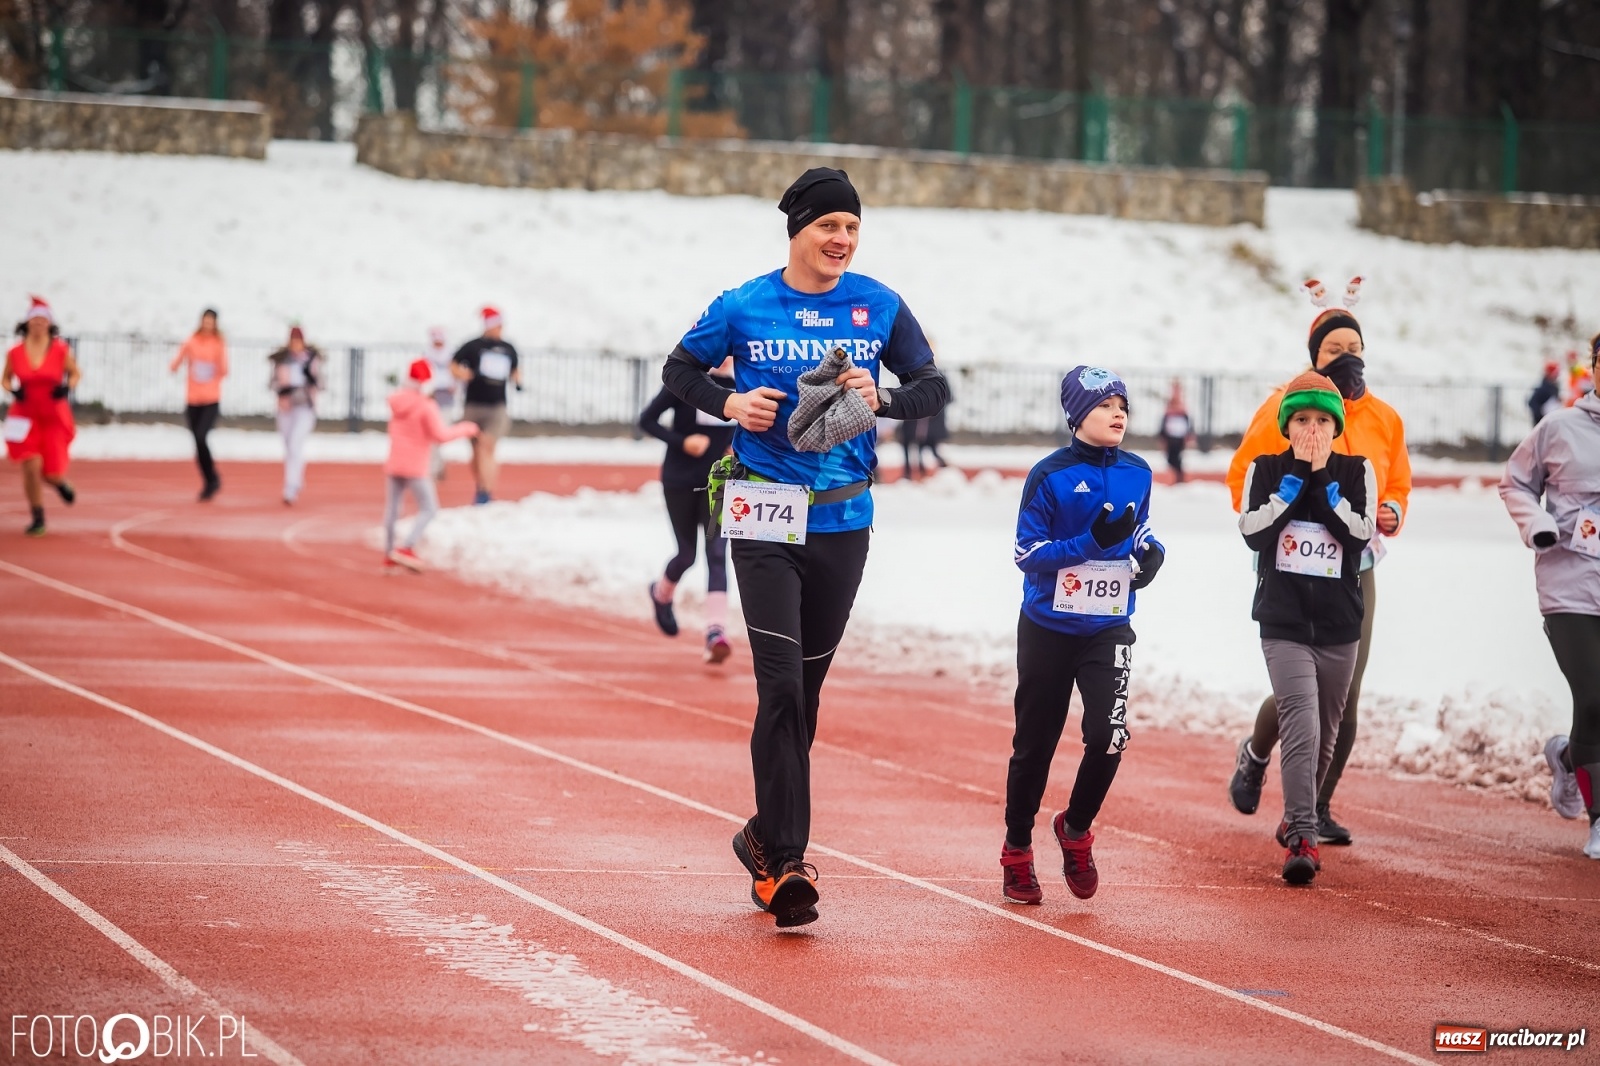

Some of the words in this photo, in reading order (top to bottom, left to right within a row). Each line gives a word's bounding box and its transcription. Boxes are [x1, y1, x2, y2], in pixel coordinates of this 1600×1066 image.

[795, 308, 819, 319] eko
[802, 318, 834, 327] okna
[747, 339, 882, 361] RUNNERS
[753, 502, 794, 524] 174
[1299, 540, 1338, 560] 042
[1084, 579, 1121, 598] 189
